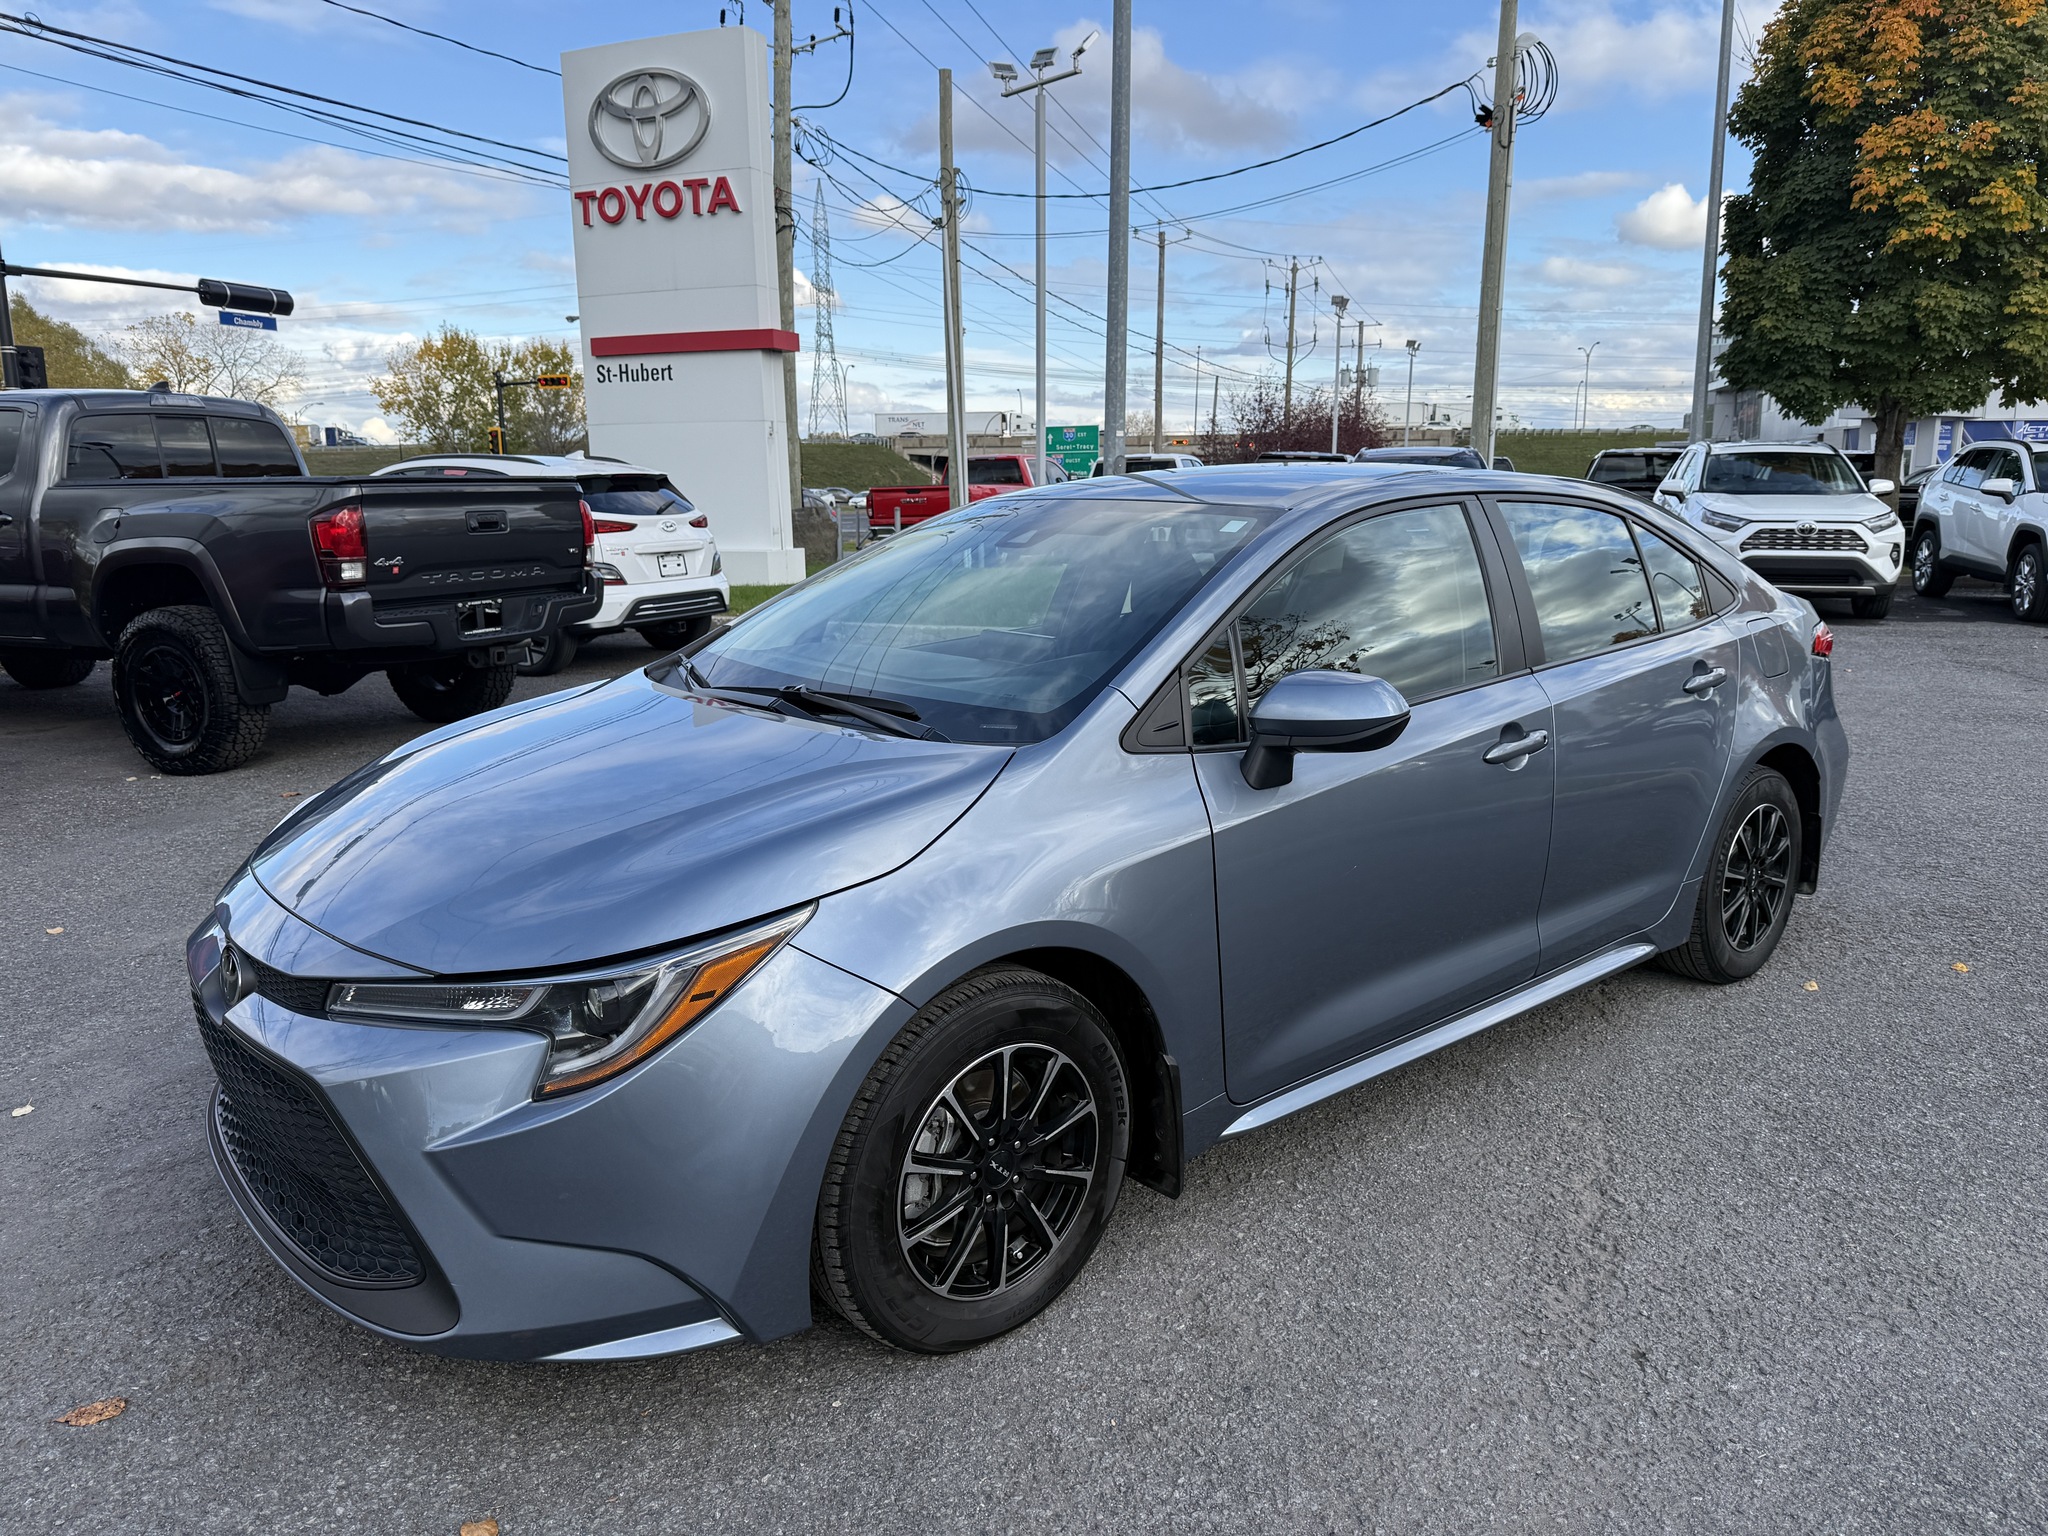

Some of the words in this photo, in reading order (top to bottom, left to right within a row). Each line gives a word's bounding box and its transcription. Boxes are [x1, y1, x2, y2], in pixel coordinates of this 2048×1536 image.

[574, 176, 743, 227] TOYOTA
[233, 316, 264, 329] Chambly
[596, 363, 674, 384] St-Hubert
[421, 566, 546, 585] TACOMA
[989, 1160, 1010, 1178] RTX
